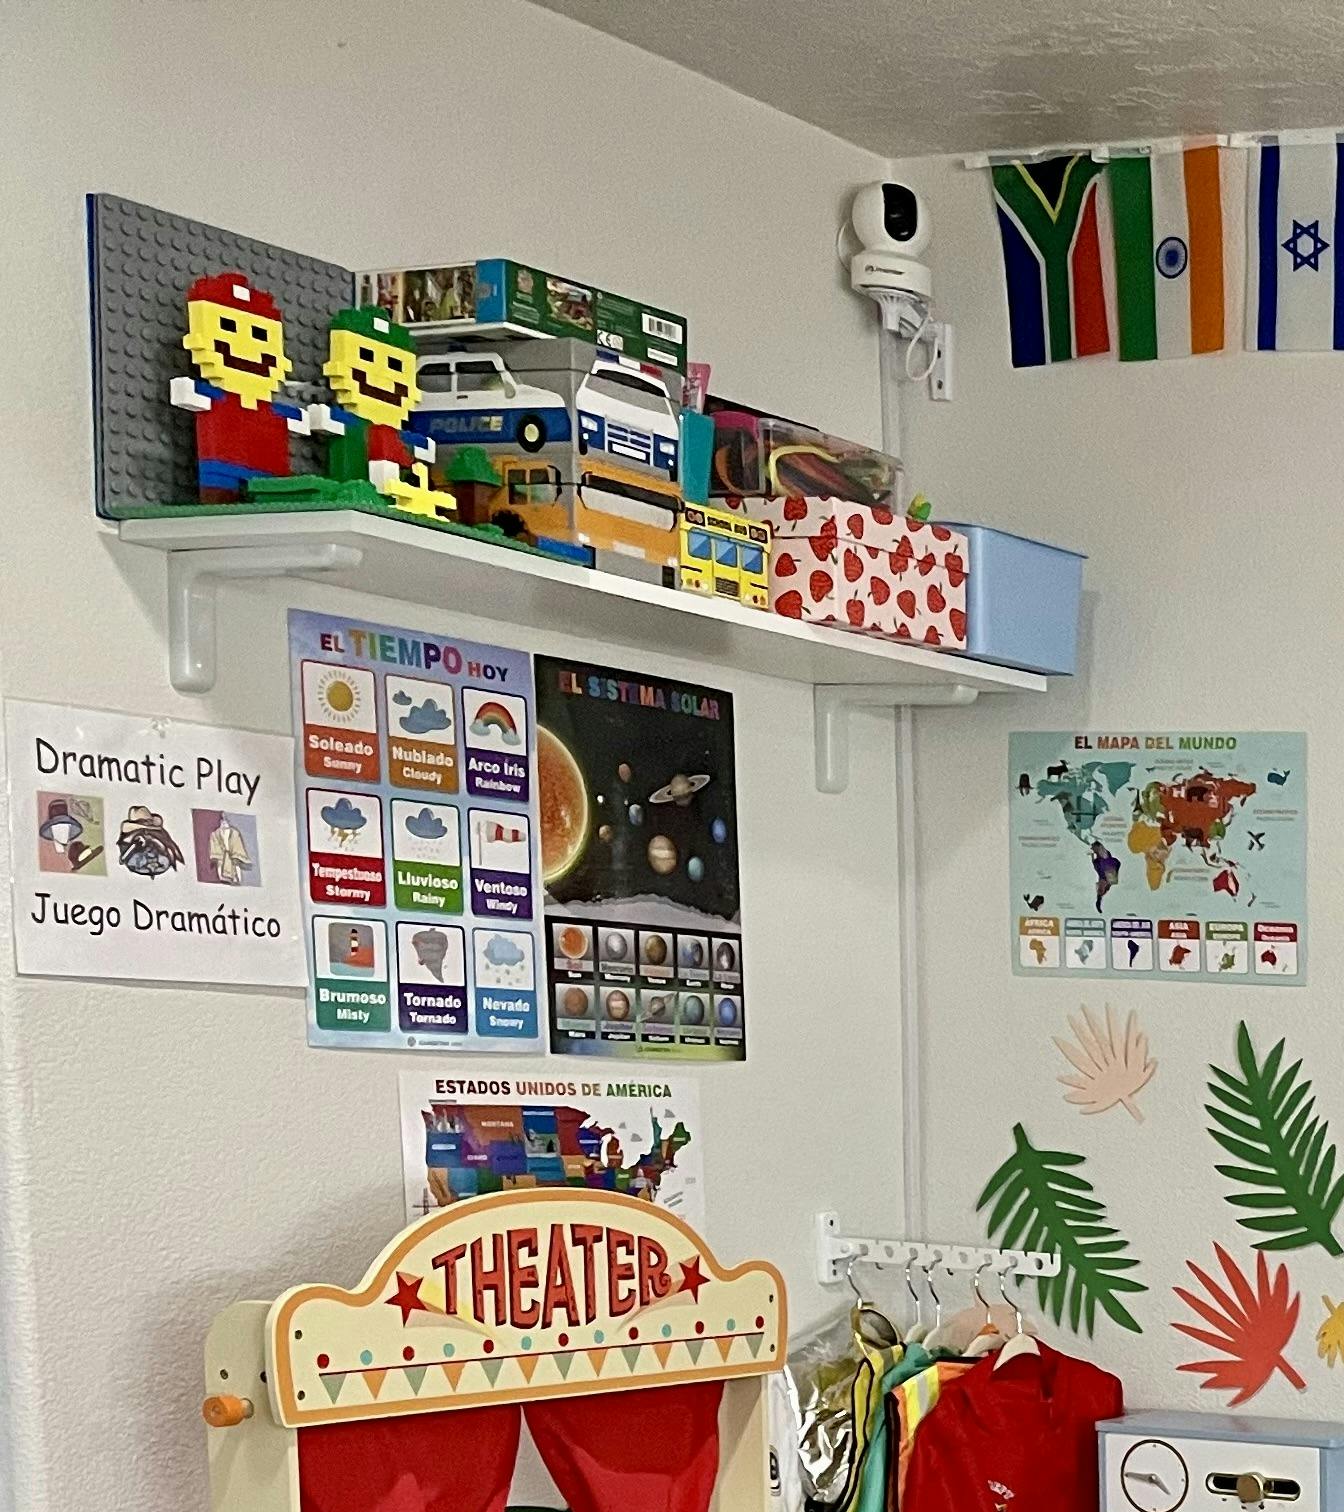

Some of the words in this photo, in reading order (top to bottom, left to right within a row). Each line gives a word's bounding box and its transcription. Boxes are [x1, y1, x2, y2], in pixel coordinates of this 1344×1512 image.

[320, 633, 344, 653] EL
[349, 629, 463, 675] TIEMPO
[468, 661, 508, 682] HOY
[559, 671, 583, 695] EL
[587, 675, 667, 711] SISTEMA
[670, 691, 720, 721] SOLAR
[309, 734, 374, 757] Soleado
[1075, 736, 1093, 749] EL
[1097, 736, 1139, 750] MAPA
[1145, 737, 1173, 750] DEL
[1179, 737, 1237, 750] MUNDO
[324, 756, 362, 774] Sunny
[392, 746, 454, 768] Nublado
[468, 757, 500, 774] Arco
[36, 737, 184, 788] Dramatic
[196, 757, 260, 806] Play
[402, 767, 443, 785] Cloudy
[475, 776, 521, 793] Rainbow
[397, 871, 458, 890] Lluvioso
[474, 878, 528, 897] Ventoso
[326, 884, 371, 902] Stormy
[412, 892, 446, 908] Rainy
[31, 892, 120, 936] Juego
[133, 899, 281, 938] Dramático
[486, 899, 518, 914] Windy
[319, 988, 387, 1006] Brumoso
[403, 992, 462, 1010] Tornado
[482, 997, 530, 1013] Nevado
[337, 1009, 370, 1023] Misty
[409, 1012, 457, 1026] Tornado
[489, 1015, 524, 1030] Snowy
[436, 1079, 511, 1096] ESTADOS
[516, 1081, 577, 1097] UNIDOS
[582, 1083, 602, 1097] DE
[606, 1080, 672, 1098] AMÉRICA
[431, 1222, 673, 1331] THEATER
